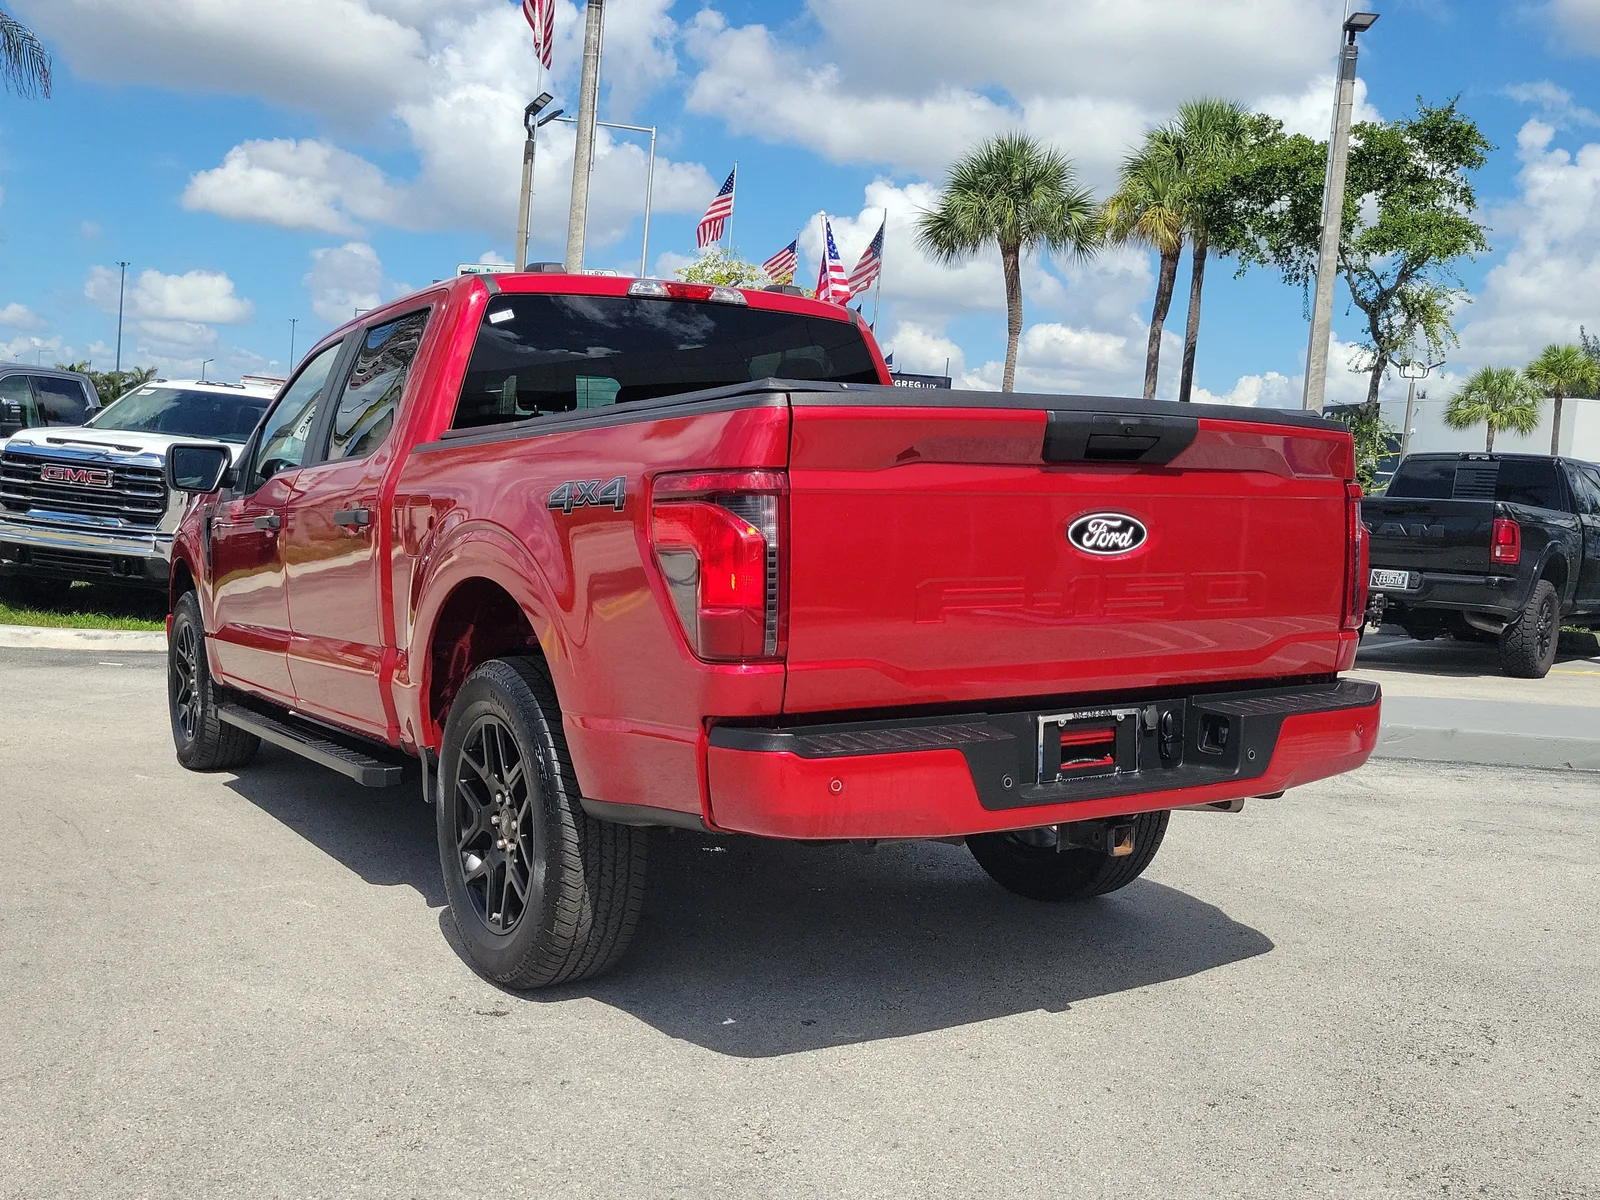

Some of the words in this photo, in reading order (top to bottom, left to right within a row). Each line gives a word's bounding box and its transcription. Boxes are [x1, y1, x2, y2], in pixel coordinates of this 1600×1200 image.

[892, 379, 921, 389] GREG
[44, 466, 108, 484] GMC
[1082, 517, 1133, 548] Ford
